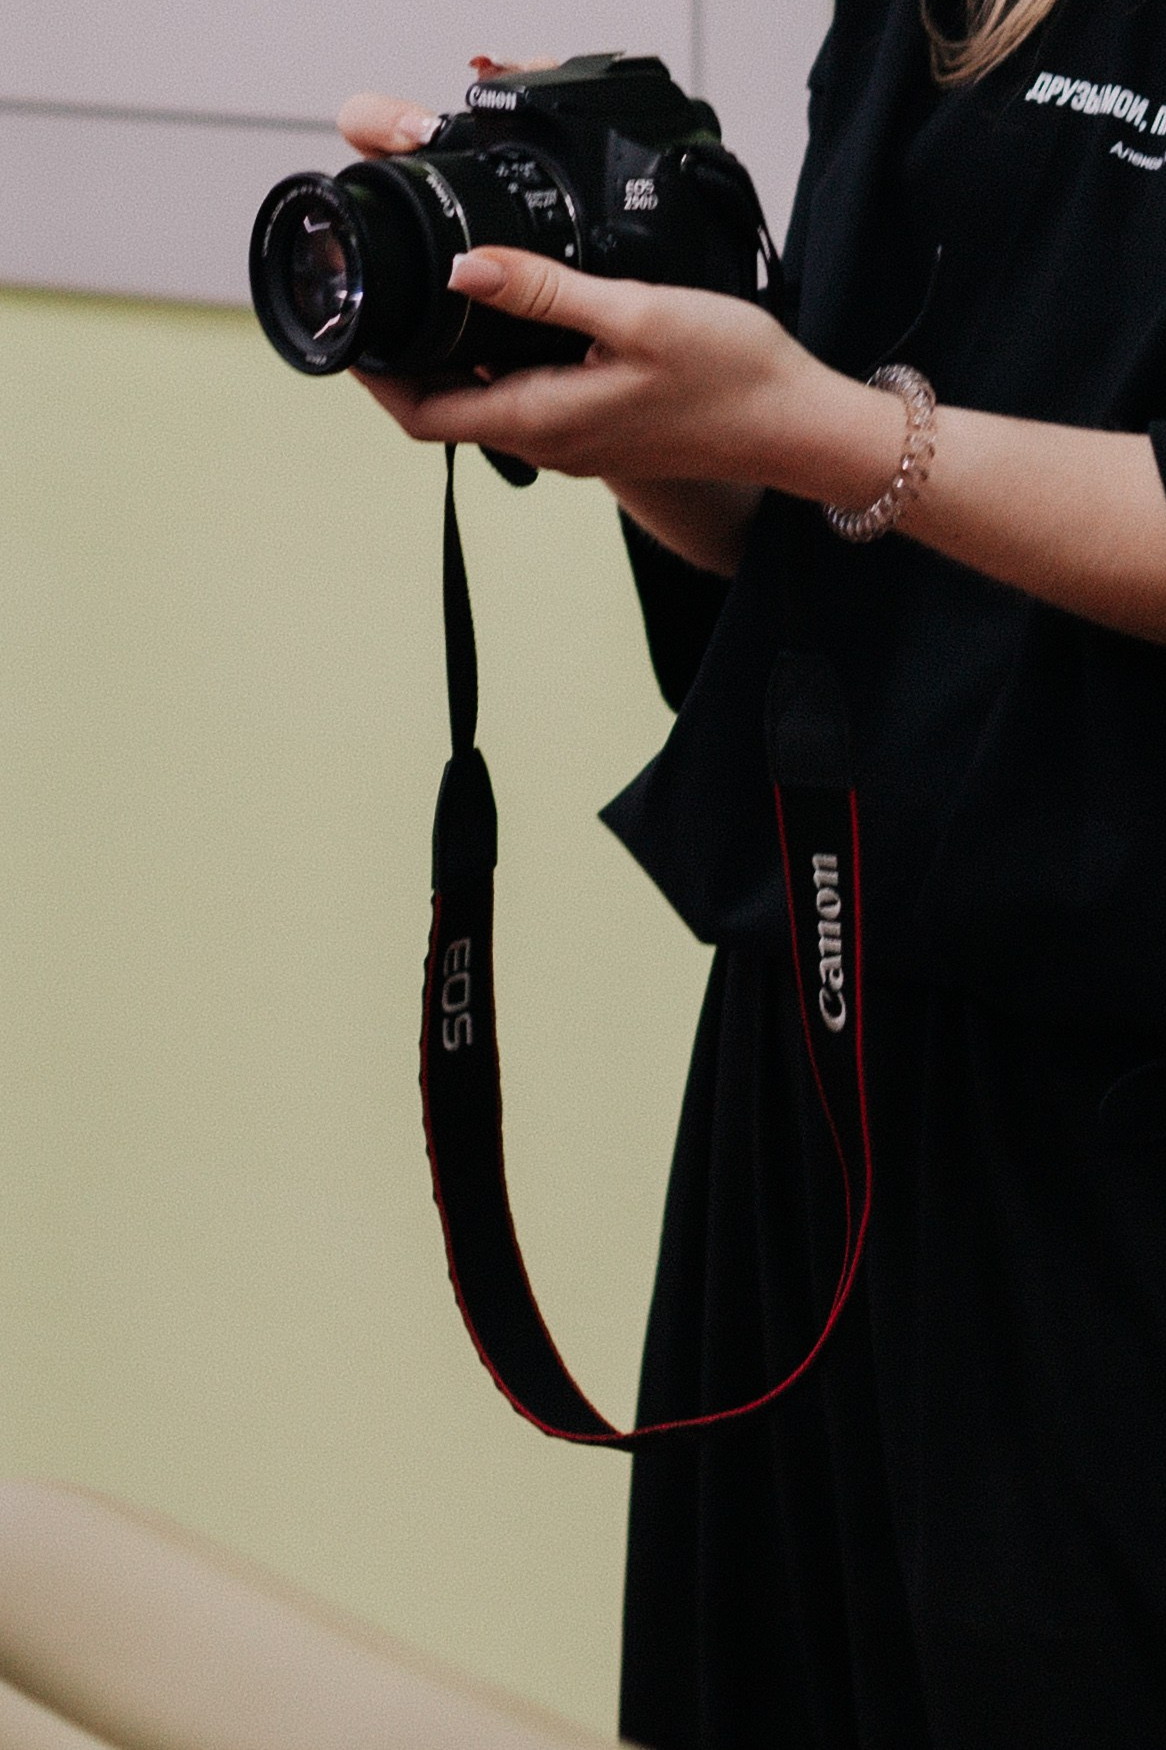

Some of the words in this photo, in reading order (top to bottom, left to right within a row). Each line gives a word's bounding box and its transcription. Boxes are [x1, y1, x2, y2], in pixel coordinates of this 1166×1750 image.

[468, 86, 517, 110] Canon
[625, 178, 655, 195] EOS
[812, 853, 846, 1033] Canon
[441, 937, 473, 1050] EOS
